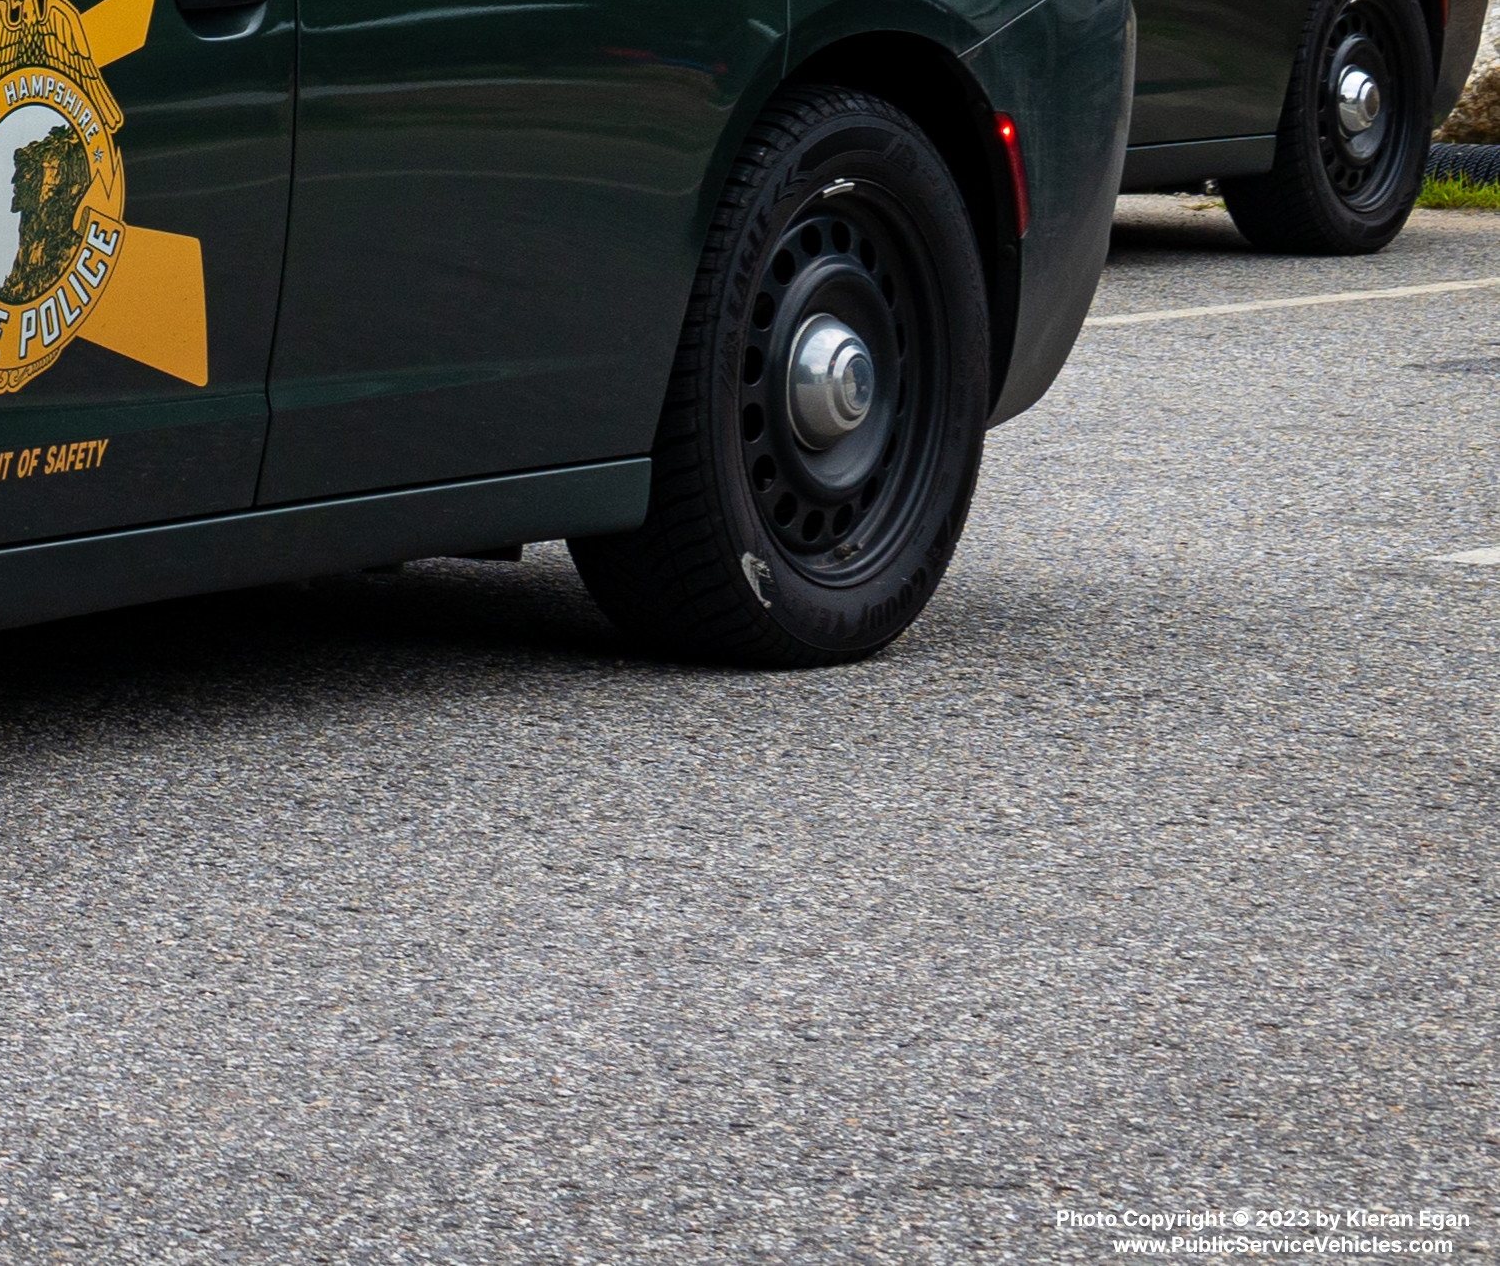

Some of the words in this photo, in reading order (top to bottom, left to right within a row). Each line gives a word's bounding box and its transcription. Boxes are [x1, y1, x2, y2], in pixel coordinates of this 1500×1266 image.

[4, 74, 101, 144] HAMPSHIRE
[18, 220, 120, 360] POLICE
[17, 447, 42, 479] OF
[44, 438, 109, 475] SAFETY
